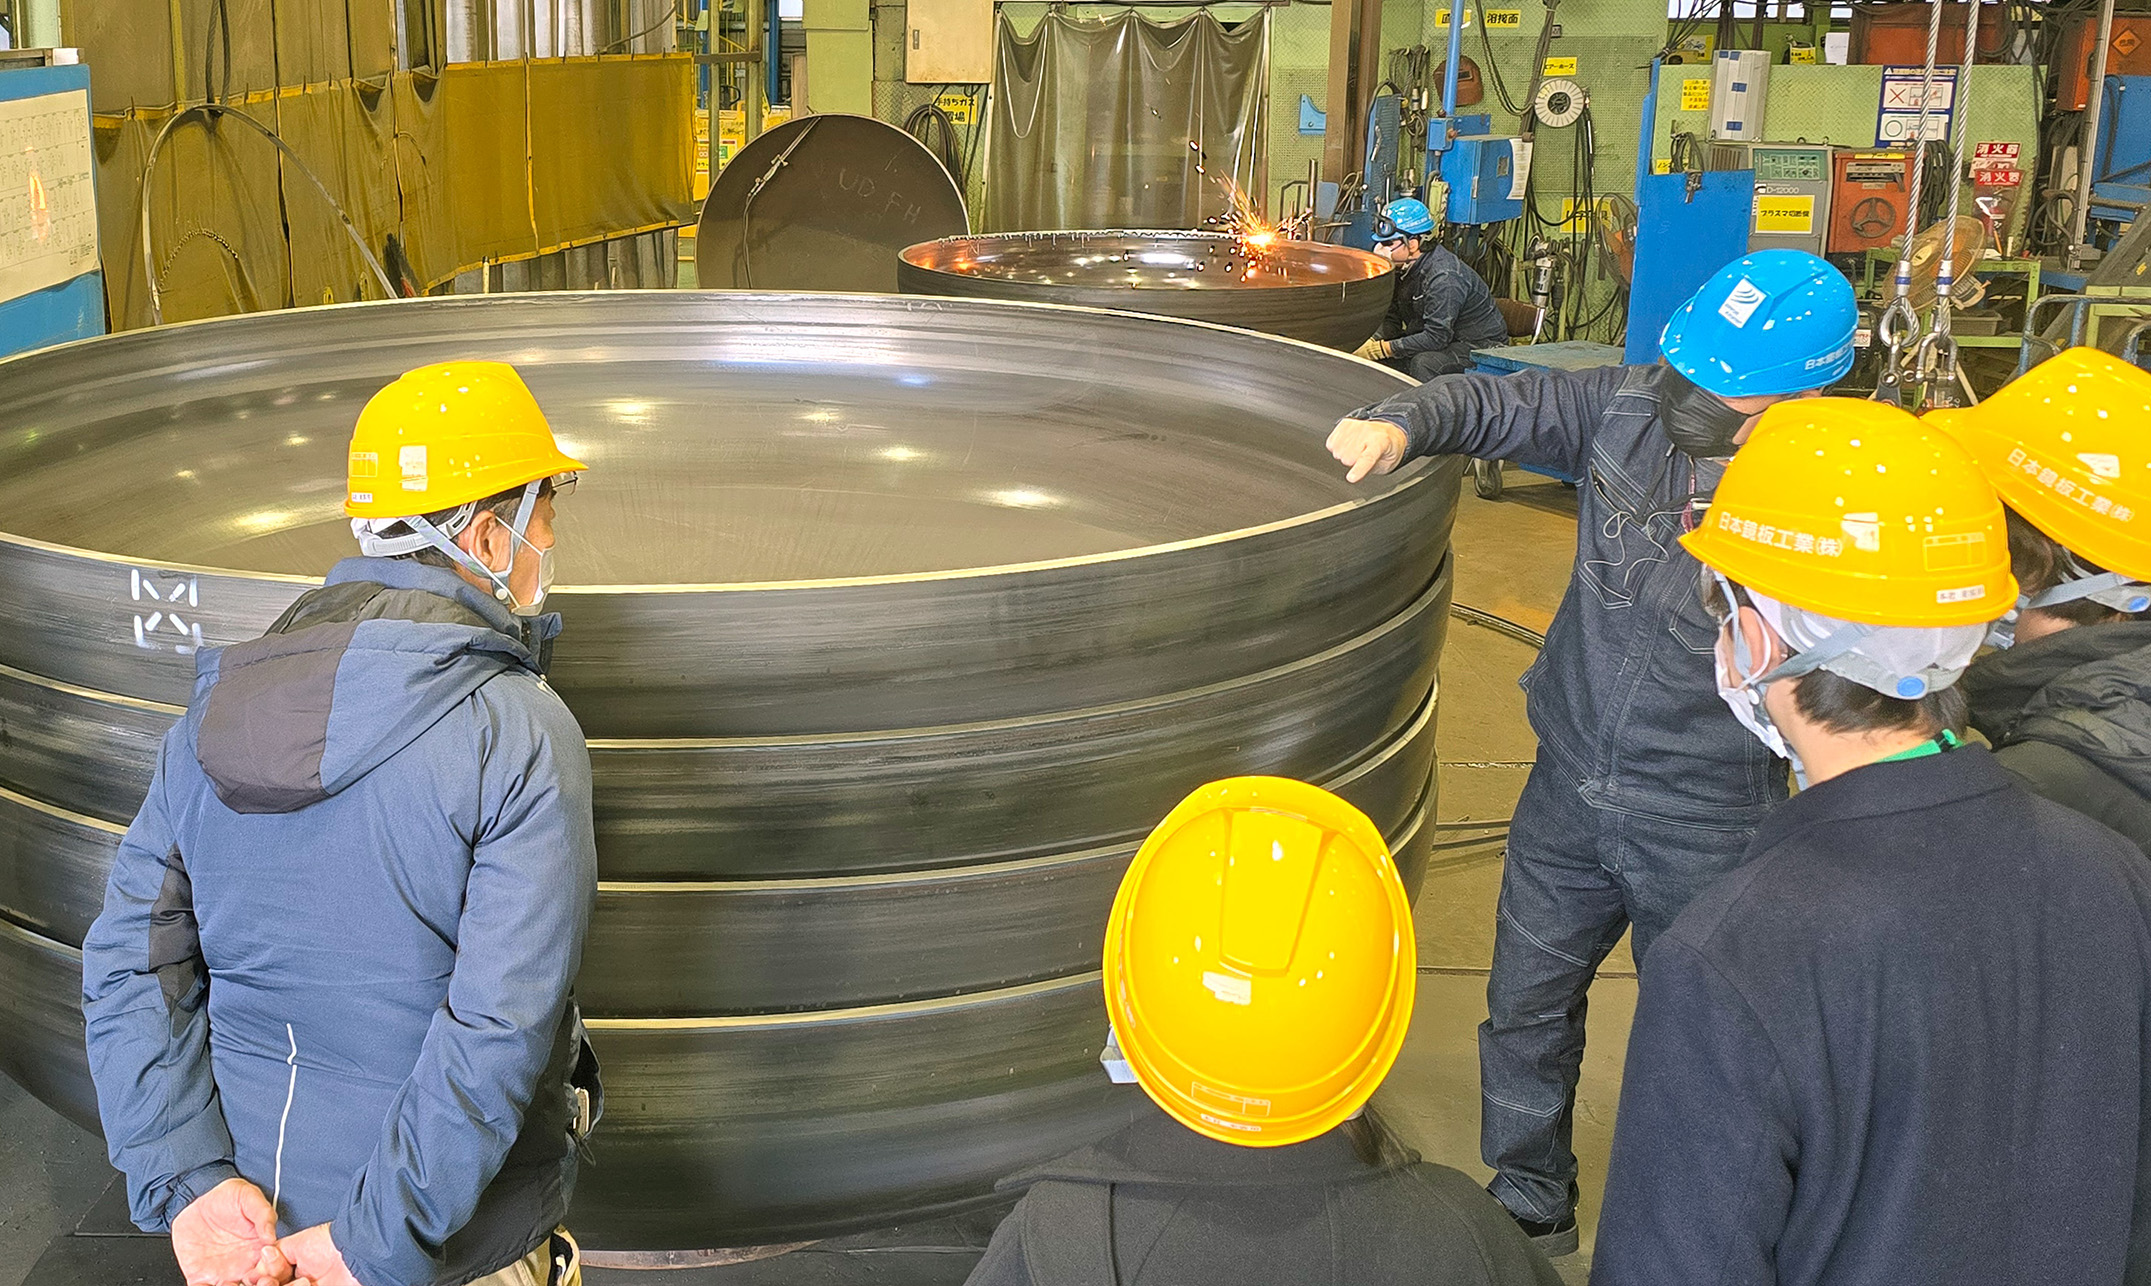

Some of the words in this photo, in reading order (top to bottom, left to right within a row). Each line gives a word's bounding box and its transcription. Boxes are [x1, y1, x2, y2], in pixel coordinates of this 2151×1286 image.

[1976, 143, 2019, 155] 消火器
[1979, 171, 2020, 183] 消火器
